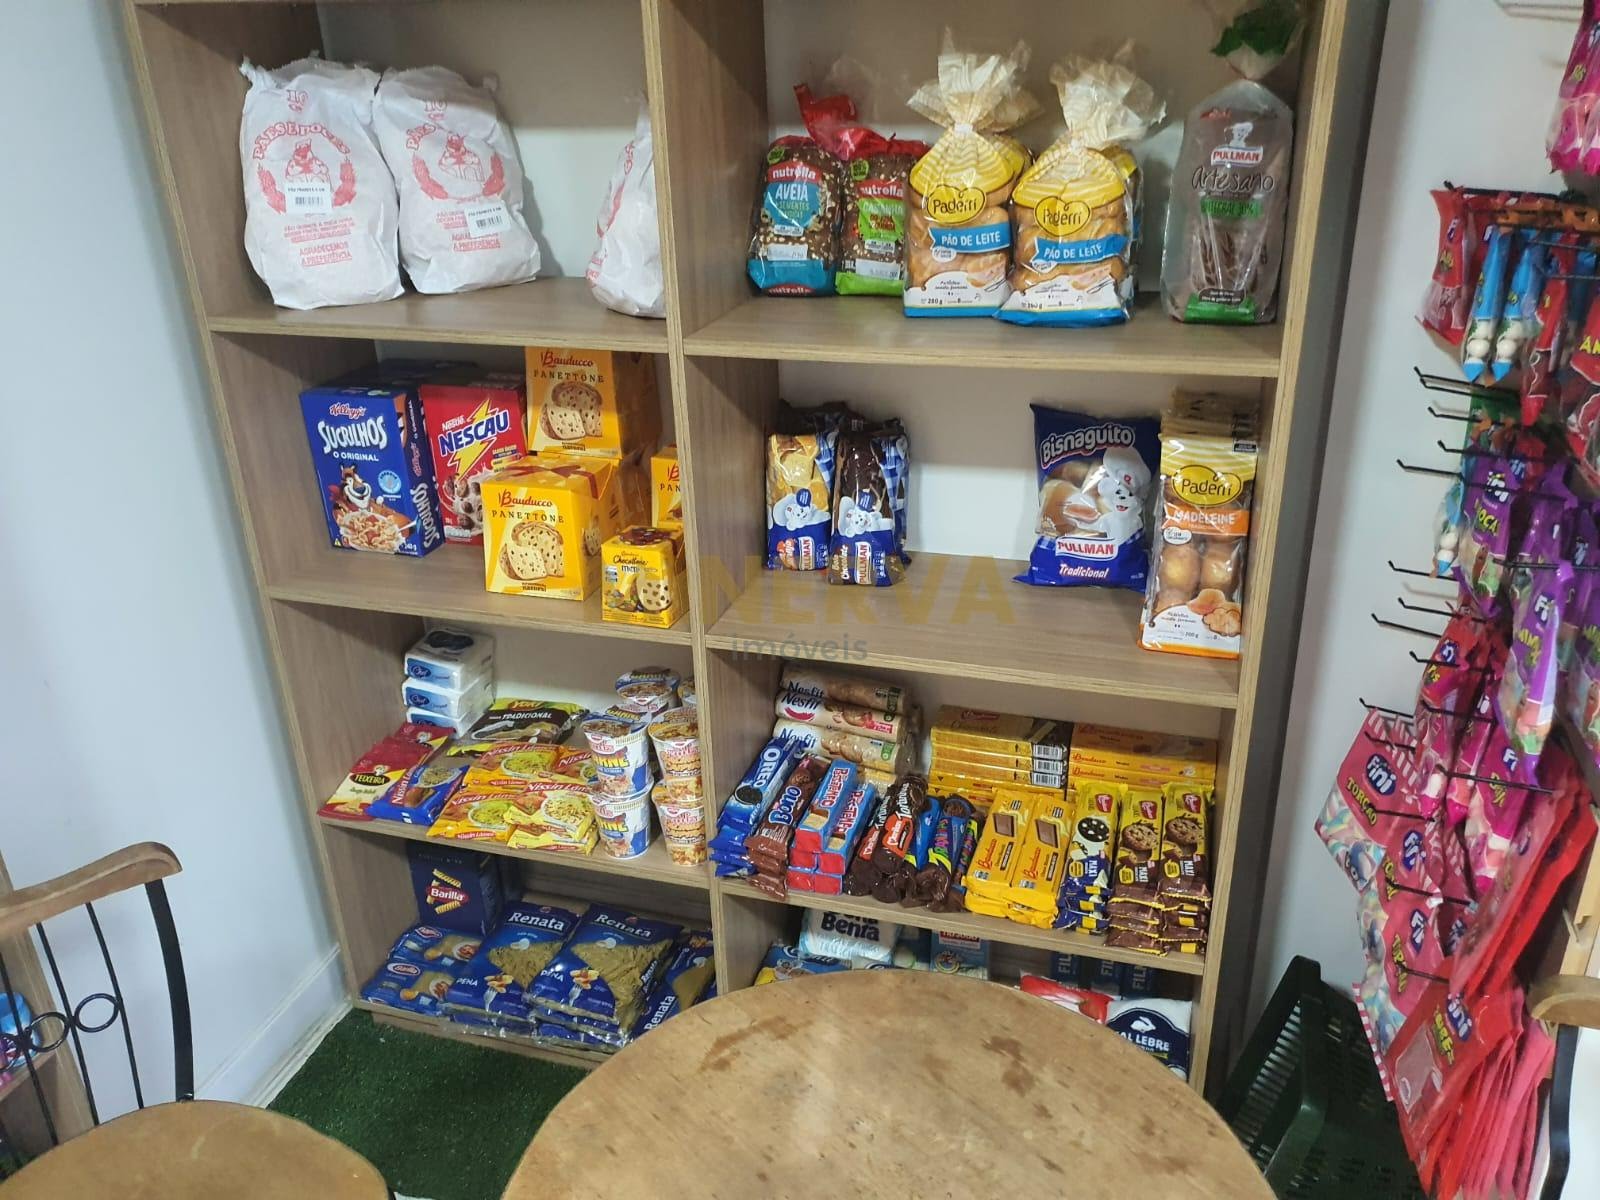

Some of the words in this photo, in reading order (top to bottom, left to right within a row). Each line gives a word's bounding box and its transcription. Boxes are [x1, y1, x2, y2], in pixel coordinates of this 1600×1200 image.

[1212, 150, 1260, 162] PULLMAN
[772, 163, 817, 180] nutrella
[775, 183, 809, 201] AVEIA
[941, 233, 958, 247] PÃO
[960, 234, 973, 246] DE
[975, 231, 1001, 245] LEITE
[1043, 247, 1061, 259] PÃO
[1062, 248, 1076, 259] DE
[1079, 244, 1103, 257] LEITE
[540, 350, 594, 369] Bauducco
[533, 369, 605, 384] PANETTONE
[317, 415, 388, 454] SUCRILHOS
[438, 409, 510, 457] NESCAU
[1041, 424, 1135, 464] Bisnaguito
[341, 451, 380, 462] ORIGINAL
[498, 489, 553, 508] Bauducco
[491, 509, 564, 523] PANETTONE
[1173, 510, 1237, 526] MADELEINE
[1057, 541, 1115, 555] PULLMAN
[858, 544, 869, 583] PULLMAN
[1058, 563, 1110, 579] Tradicional
[501, 711, 553, 720] TRADICIONAL
[753, 747, 783, 788] OREO
[1366, 755, 1397, 794] Fini
[527, 782, 562, 792] Nissin
[430, 887, 464, 901] Barilla
[507, 911, 566, 932] Renata
[595, 913, 652, 938] Renata
[820, 911, 880, 942] Benta
[643, 994, 676, 1030] Renata
[1135, 1035, 1170, 1052] LEBRE
